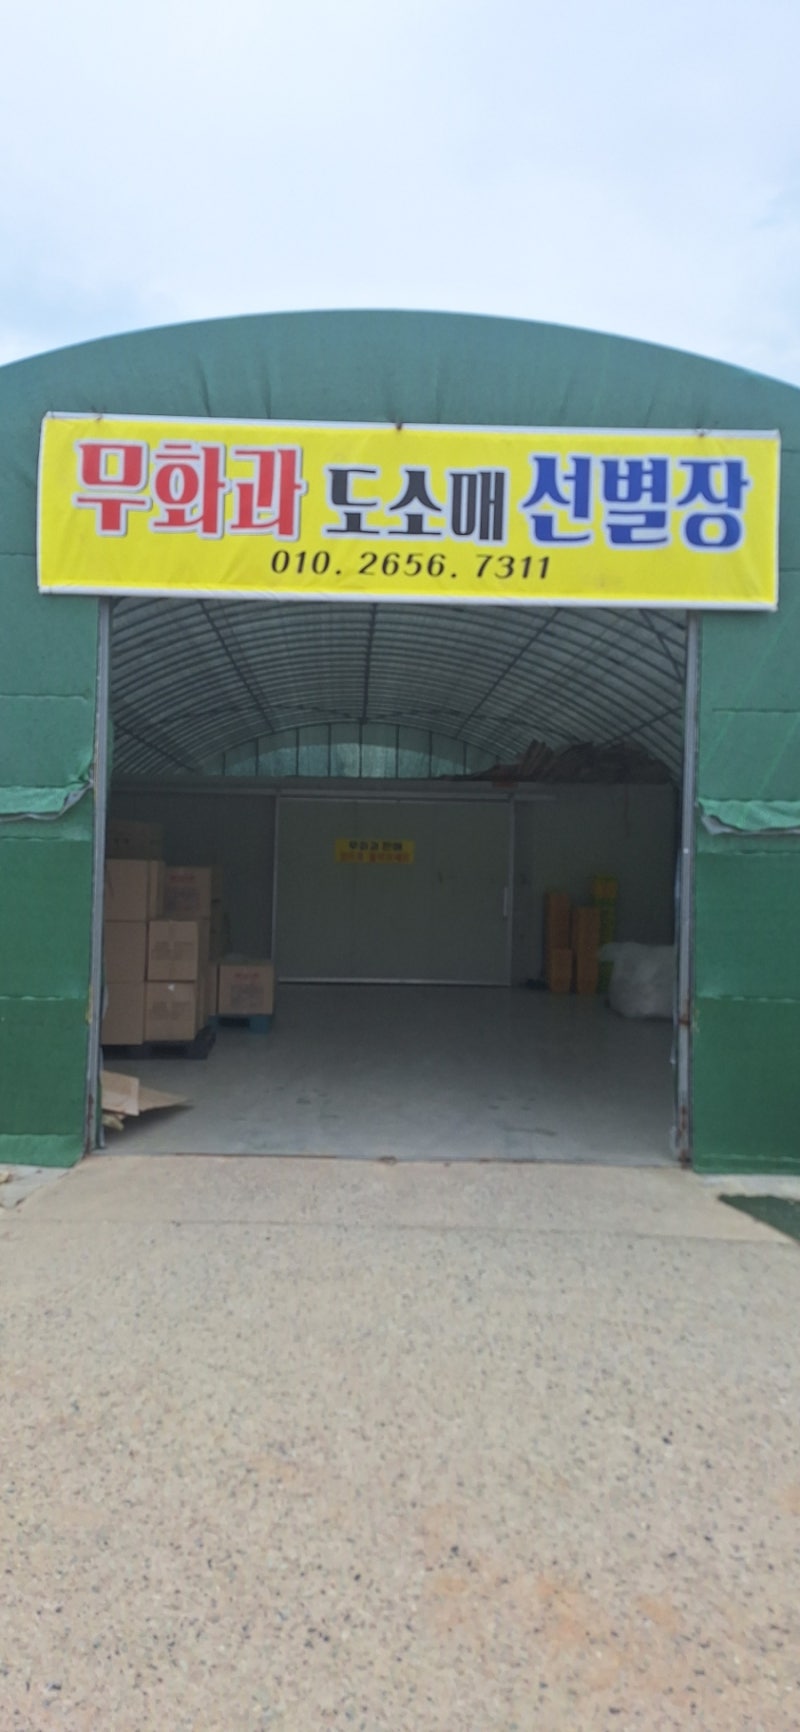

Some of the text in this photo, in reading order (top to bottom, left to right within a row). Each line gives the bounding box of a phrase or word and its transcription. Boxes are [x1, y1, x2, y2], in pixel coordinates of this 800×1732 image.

[75, 441, 751, 550] 무화과 도소매 선별장
[475, 553, 551, 580] 7311
